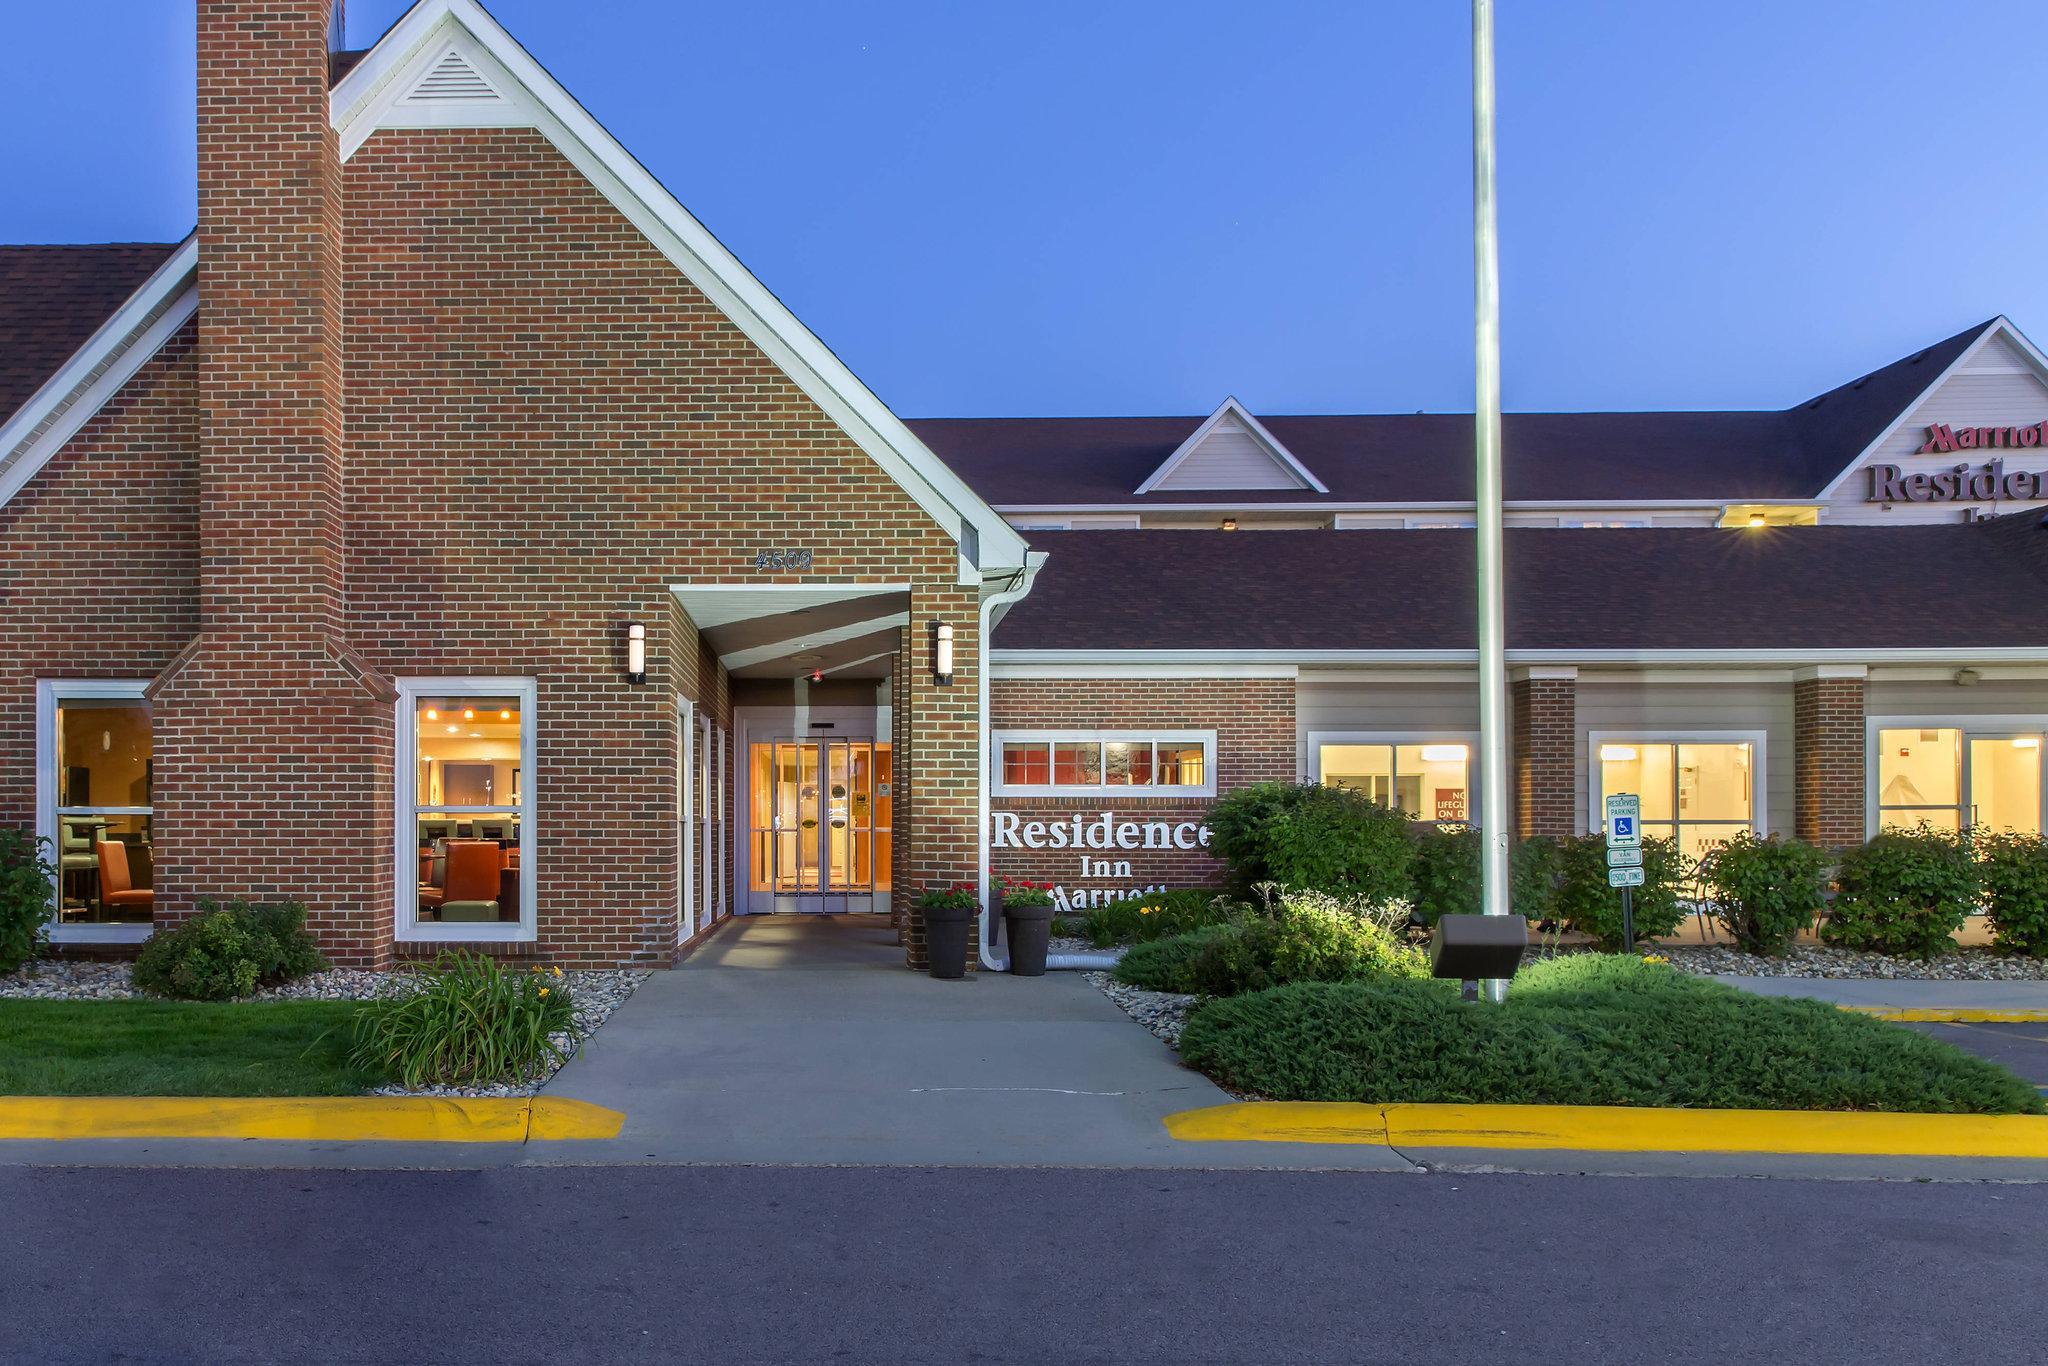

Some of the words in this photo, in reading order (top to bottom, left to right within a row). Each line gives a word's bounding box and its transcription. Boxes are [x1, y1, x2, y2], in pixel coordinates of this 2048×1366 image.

[755, 550, 812, 570] 4509
[1438, 810, 1453, 818] ON
[1080, 855, 1133, 878] Inn
